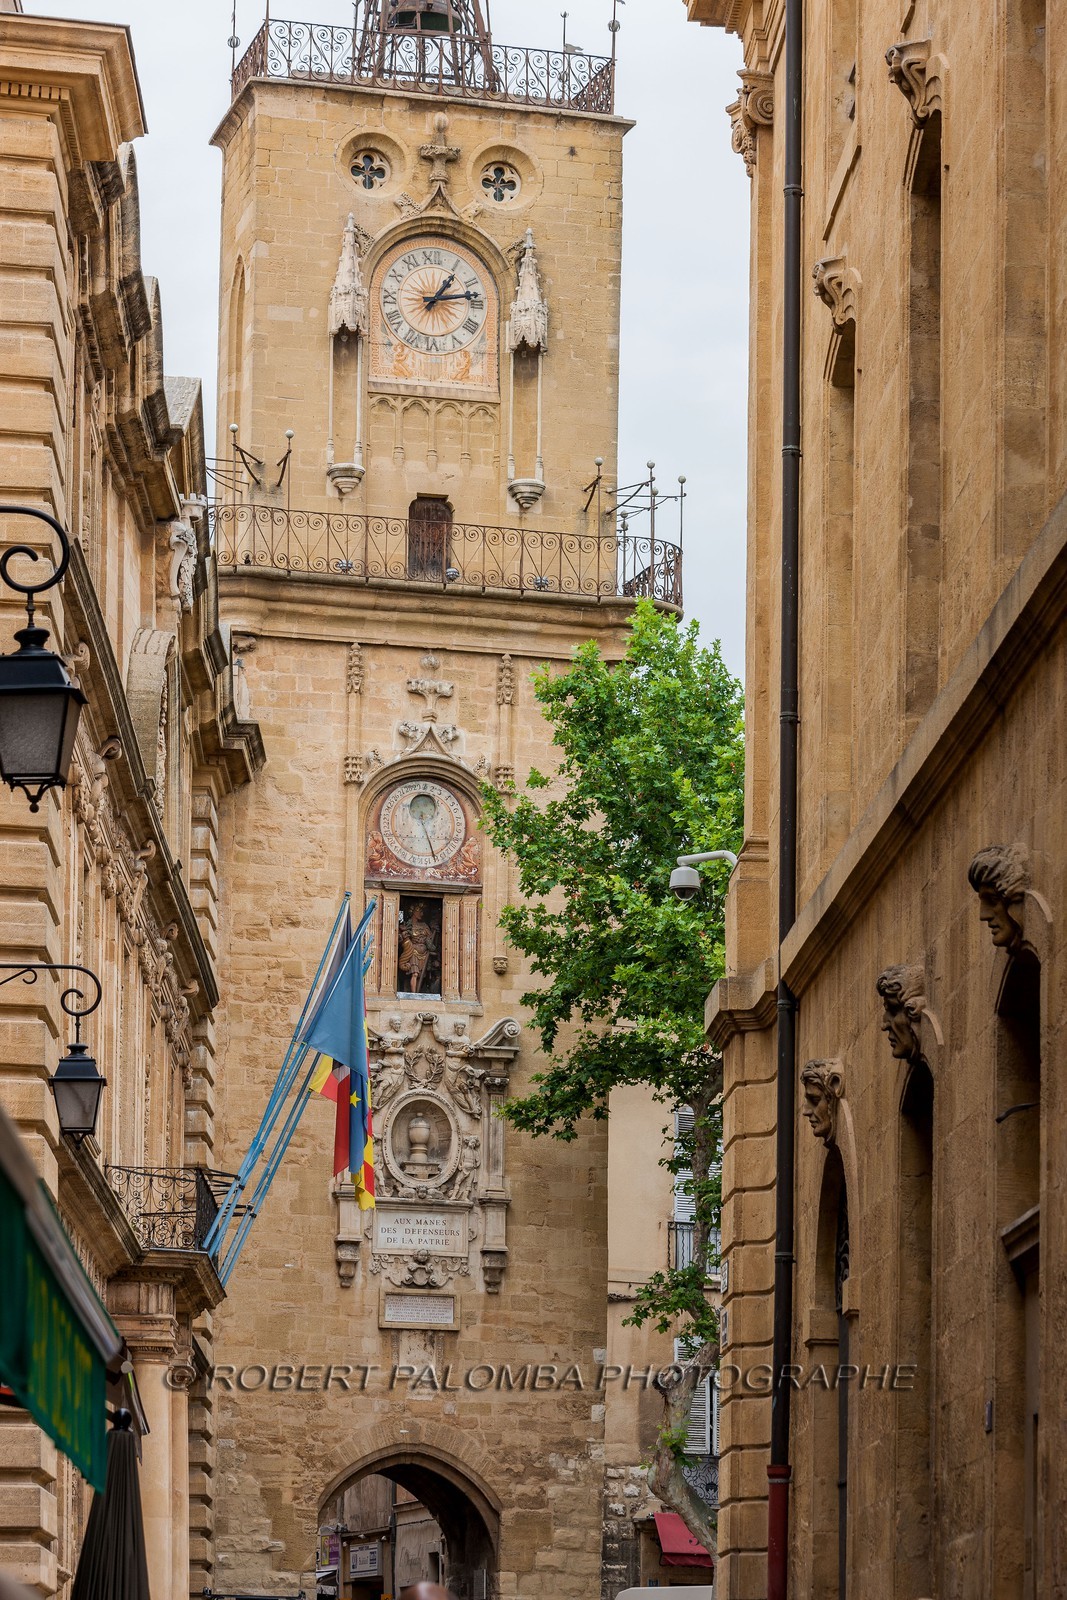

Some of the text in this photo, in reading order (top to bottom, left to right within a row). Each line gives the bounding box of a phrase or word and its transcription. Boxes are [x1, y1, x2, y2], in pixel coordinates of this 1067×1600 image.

[402, 253, 420, 271] XI
[422, 250, 441, 265] XII
[451, 258, 460, 271] I
[388, 268, 403, 284] X
[464, 277, 478, 287] II
[383, 289, 397, 307] IX
[451, 334, 463, 349] V
[393, 1217, 412, 1225] AUX
[404, 1228, 460, 1237] DEFENSEURS
[401, 1237, 414, 1245] LA
[418, 1238, 450, 1246] PATRIE
